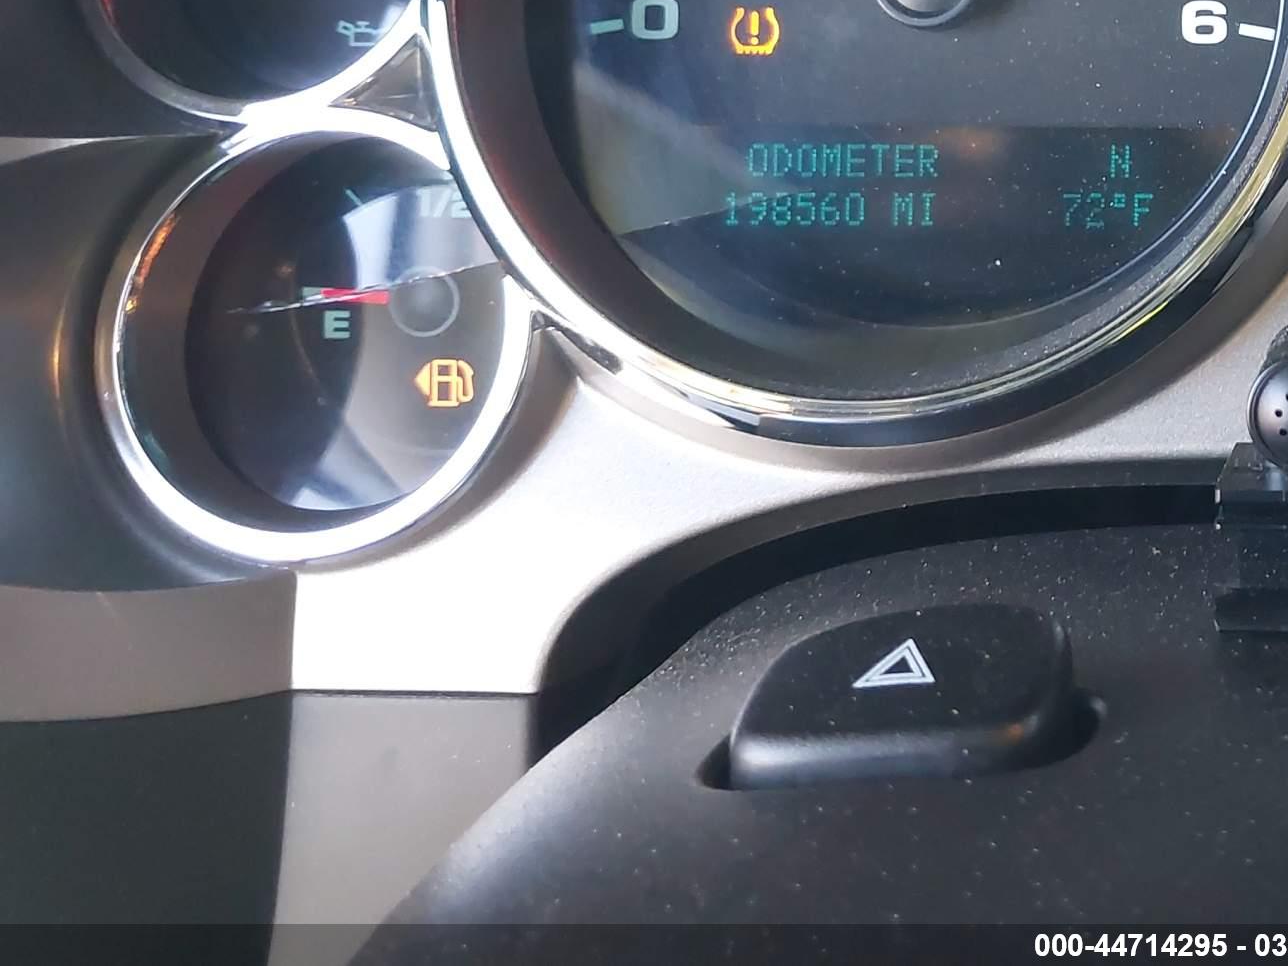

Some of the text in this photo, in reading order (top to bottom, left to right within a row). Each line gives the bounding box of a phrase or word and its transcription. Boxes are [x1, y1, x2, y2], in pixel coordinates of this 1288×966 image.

[1181, 0, 1228, 45] 6
[748, 143, 939, 178] ODOMETER
[1110, 143, 1131, 178] N
[723, 191, 937, 227] 198560 MI
[323, 310, 350, 339] E
